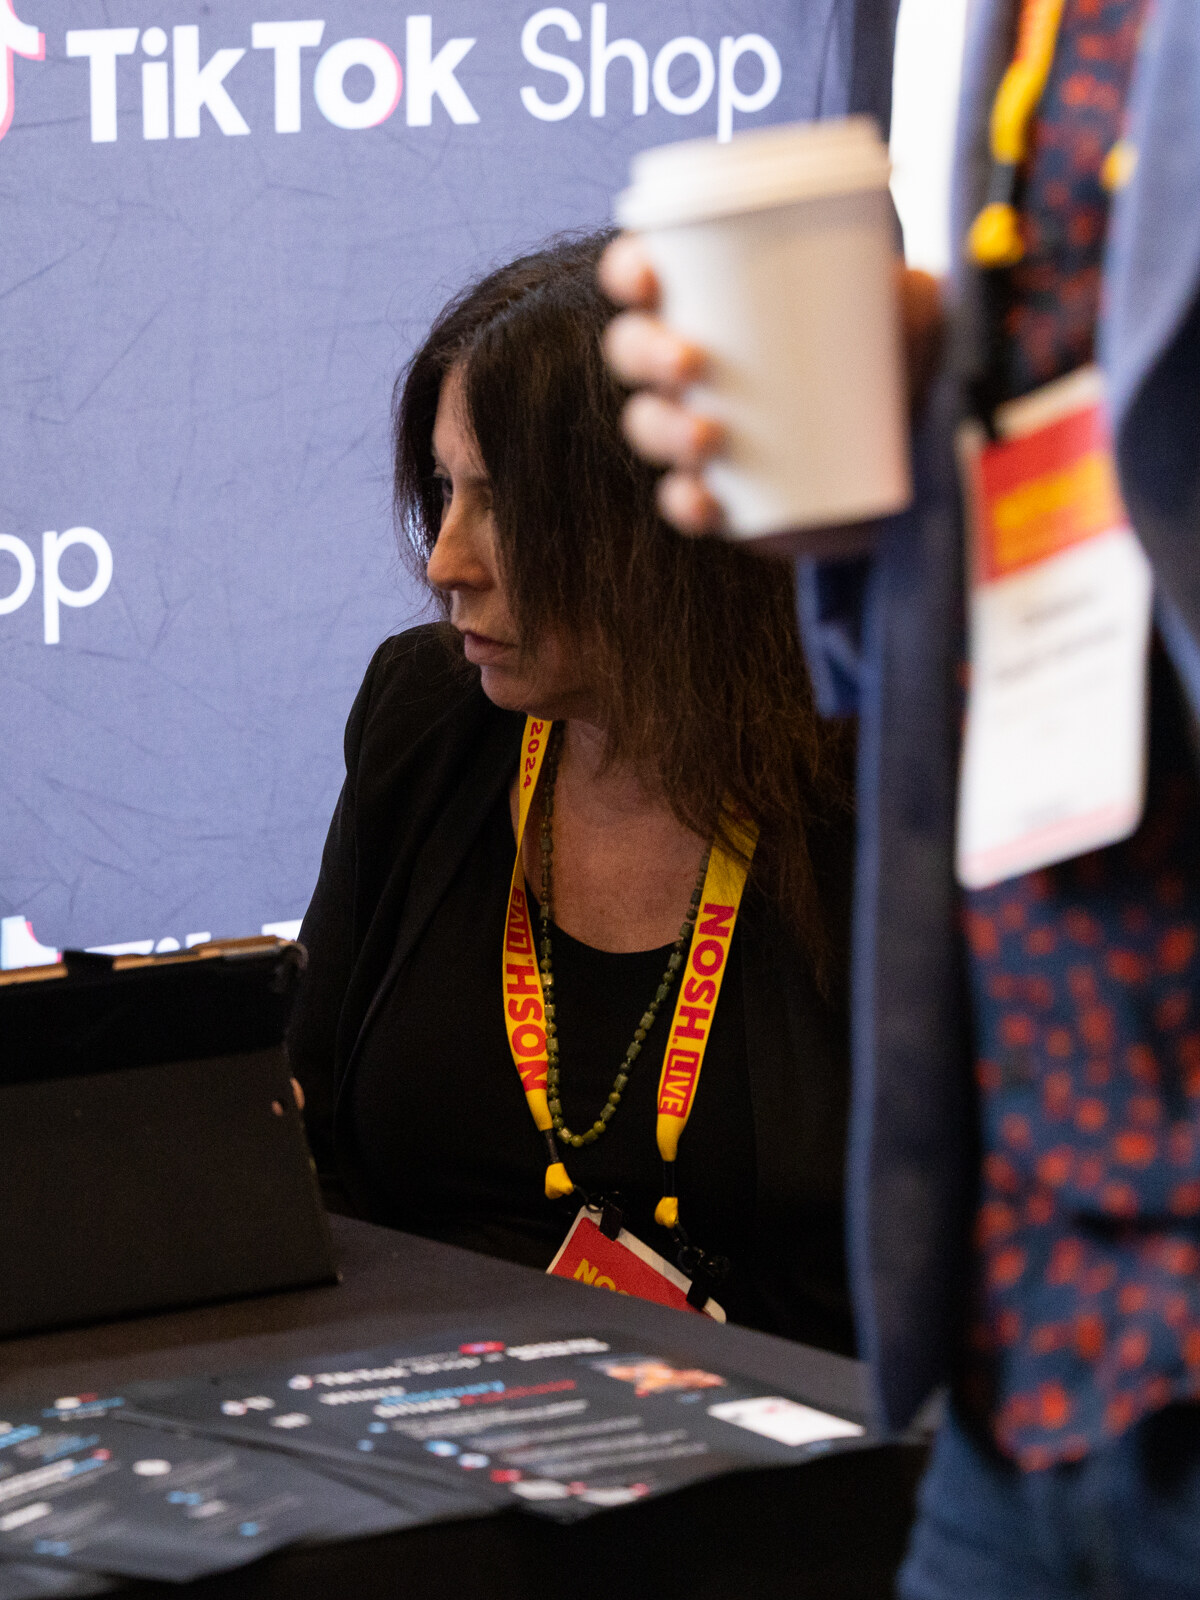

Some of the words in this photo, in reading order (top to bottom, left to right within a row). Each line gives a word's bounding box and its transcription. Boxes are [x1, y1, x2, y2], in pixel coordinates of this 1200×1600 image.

[66, 15, 480, 143] TikTok
[520, 3, 782, 143] Shop
[523, 721, 543, 789] 2024
[509, 890, 528, 948] LIVE
[674, 903, 735, 1040] NOSH
[506, 963, 548, 1092] NOSH
[660, 1055, 695, 1112] LIVE
[573, 1258, 629, 1296] NO
